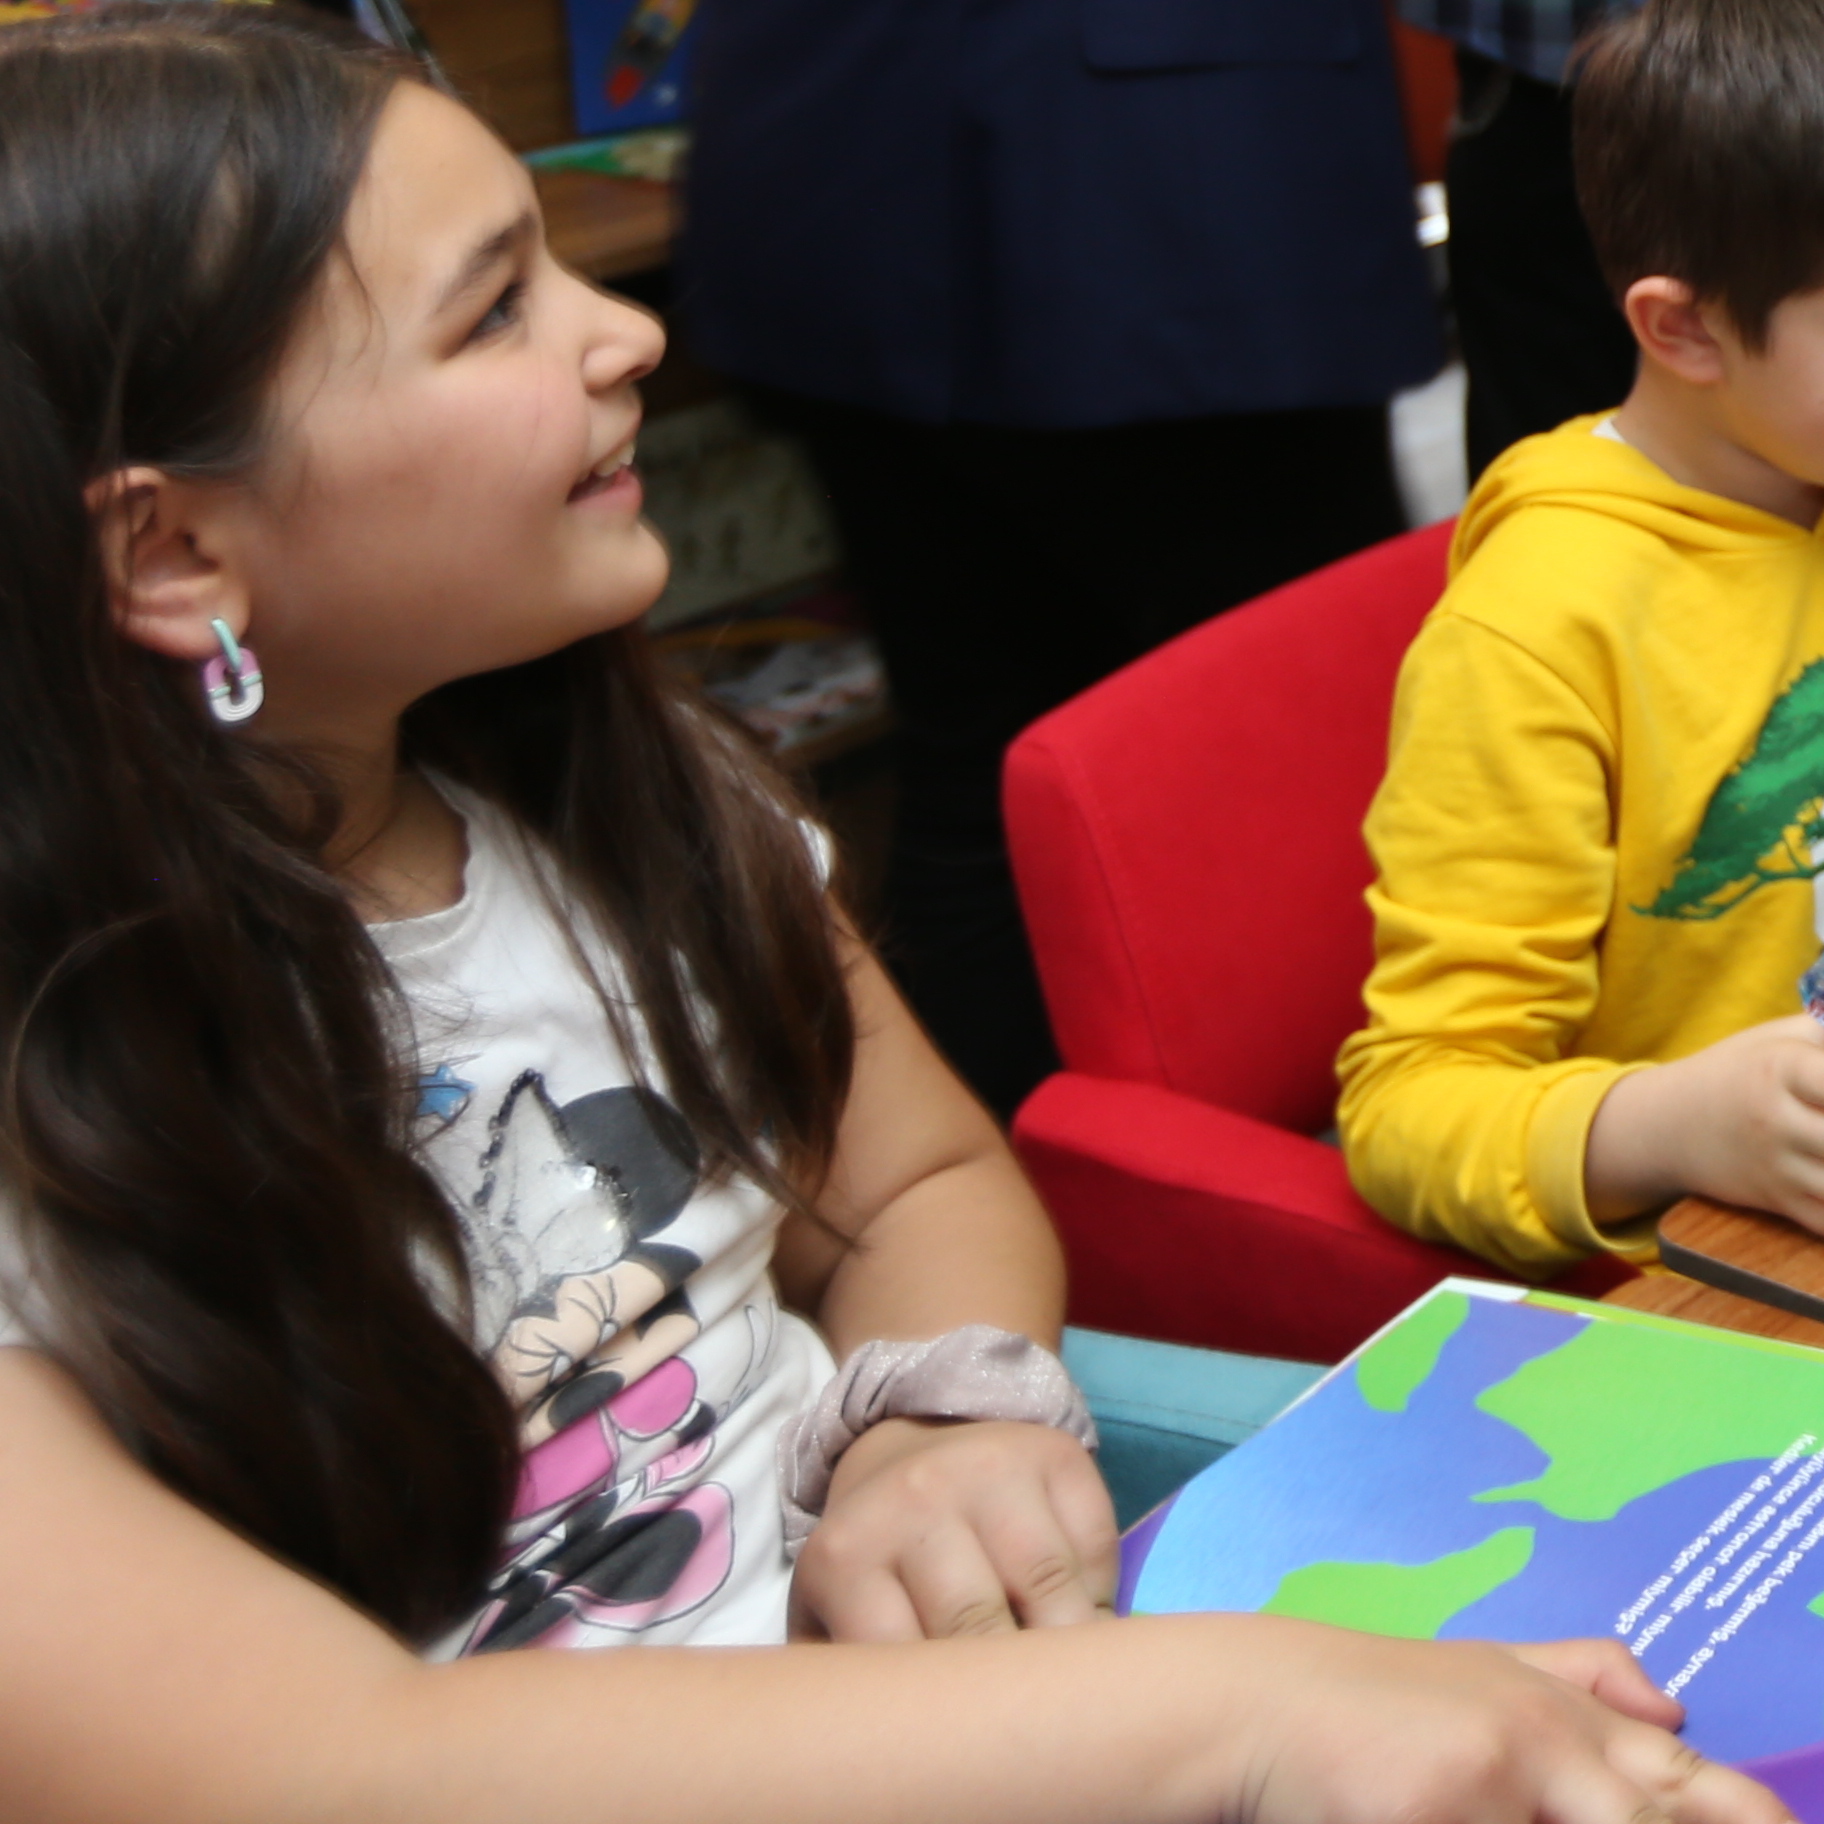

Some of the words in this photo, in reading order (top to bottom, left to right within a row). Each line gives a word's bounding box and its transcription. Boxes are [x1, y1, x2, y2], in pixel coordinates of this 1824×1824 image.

[1770, 1434, 1817, 1474] Kediler
[1750, 1475, 1772, 1492] de
[1706, 1489, 1755, 1536] meslek
[1671, 1536, 1710, 1574] seçer
[1715, 1505, 1776, 1565] astronot
[1773, 1550, 1803, 1582] pek
[1670, 1566, 1716, 1613] olabilir
[1631, 1613, 1672, 1656] miymi
